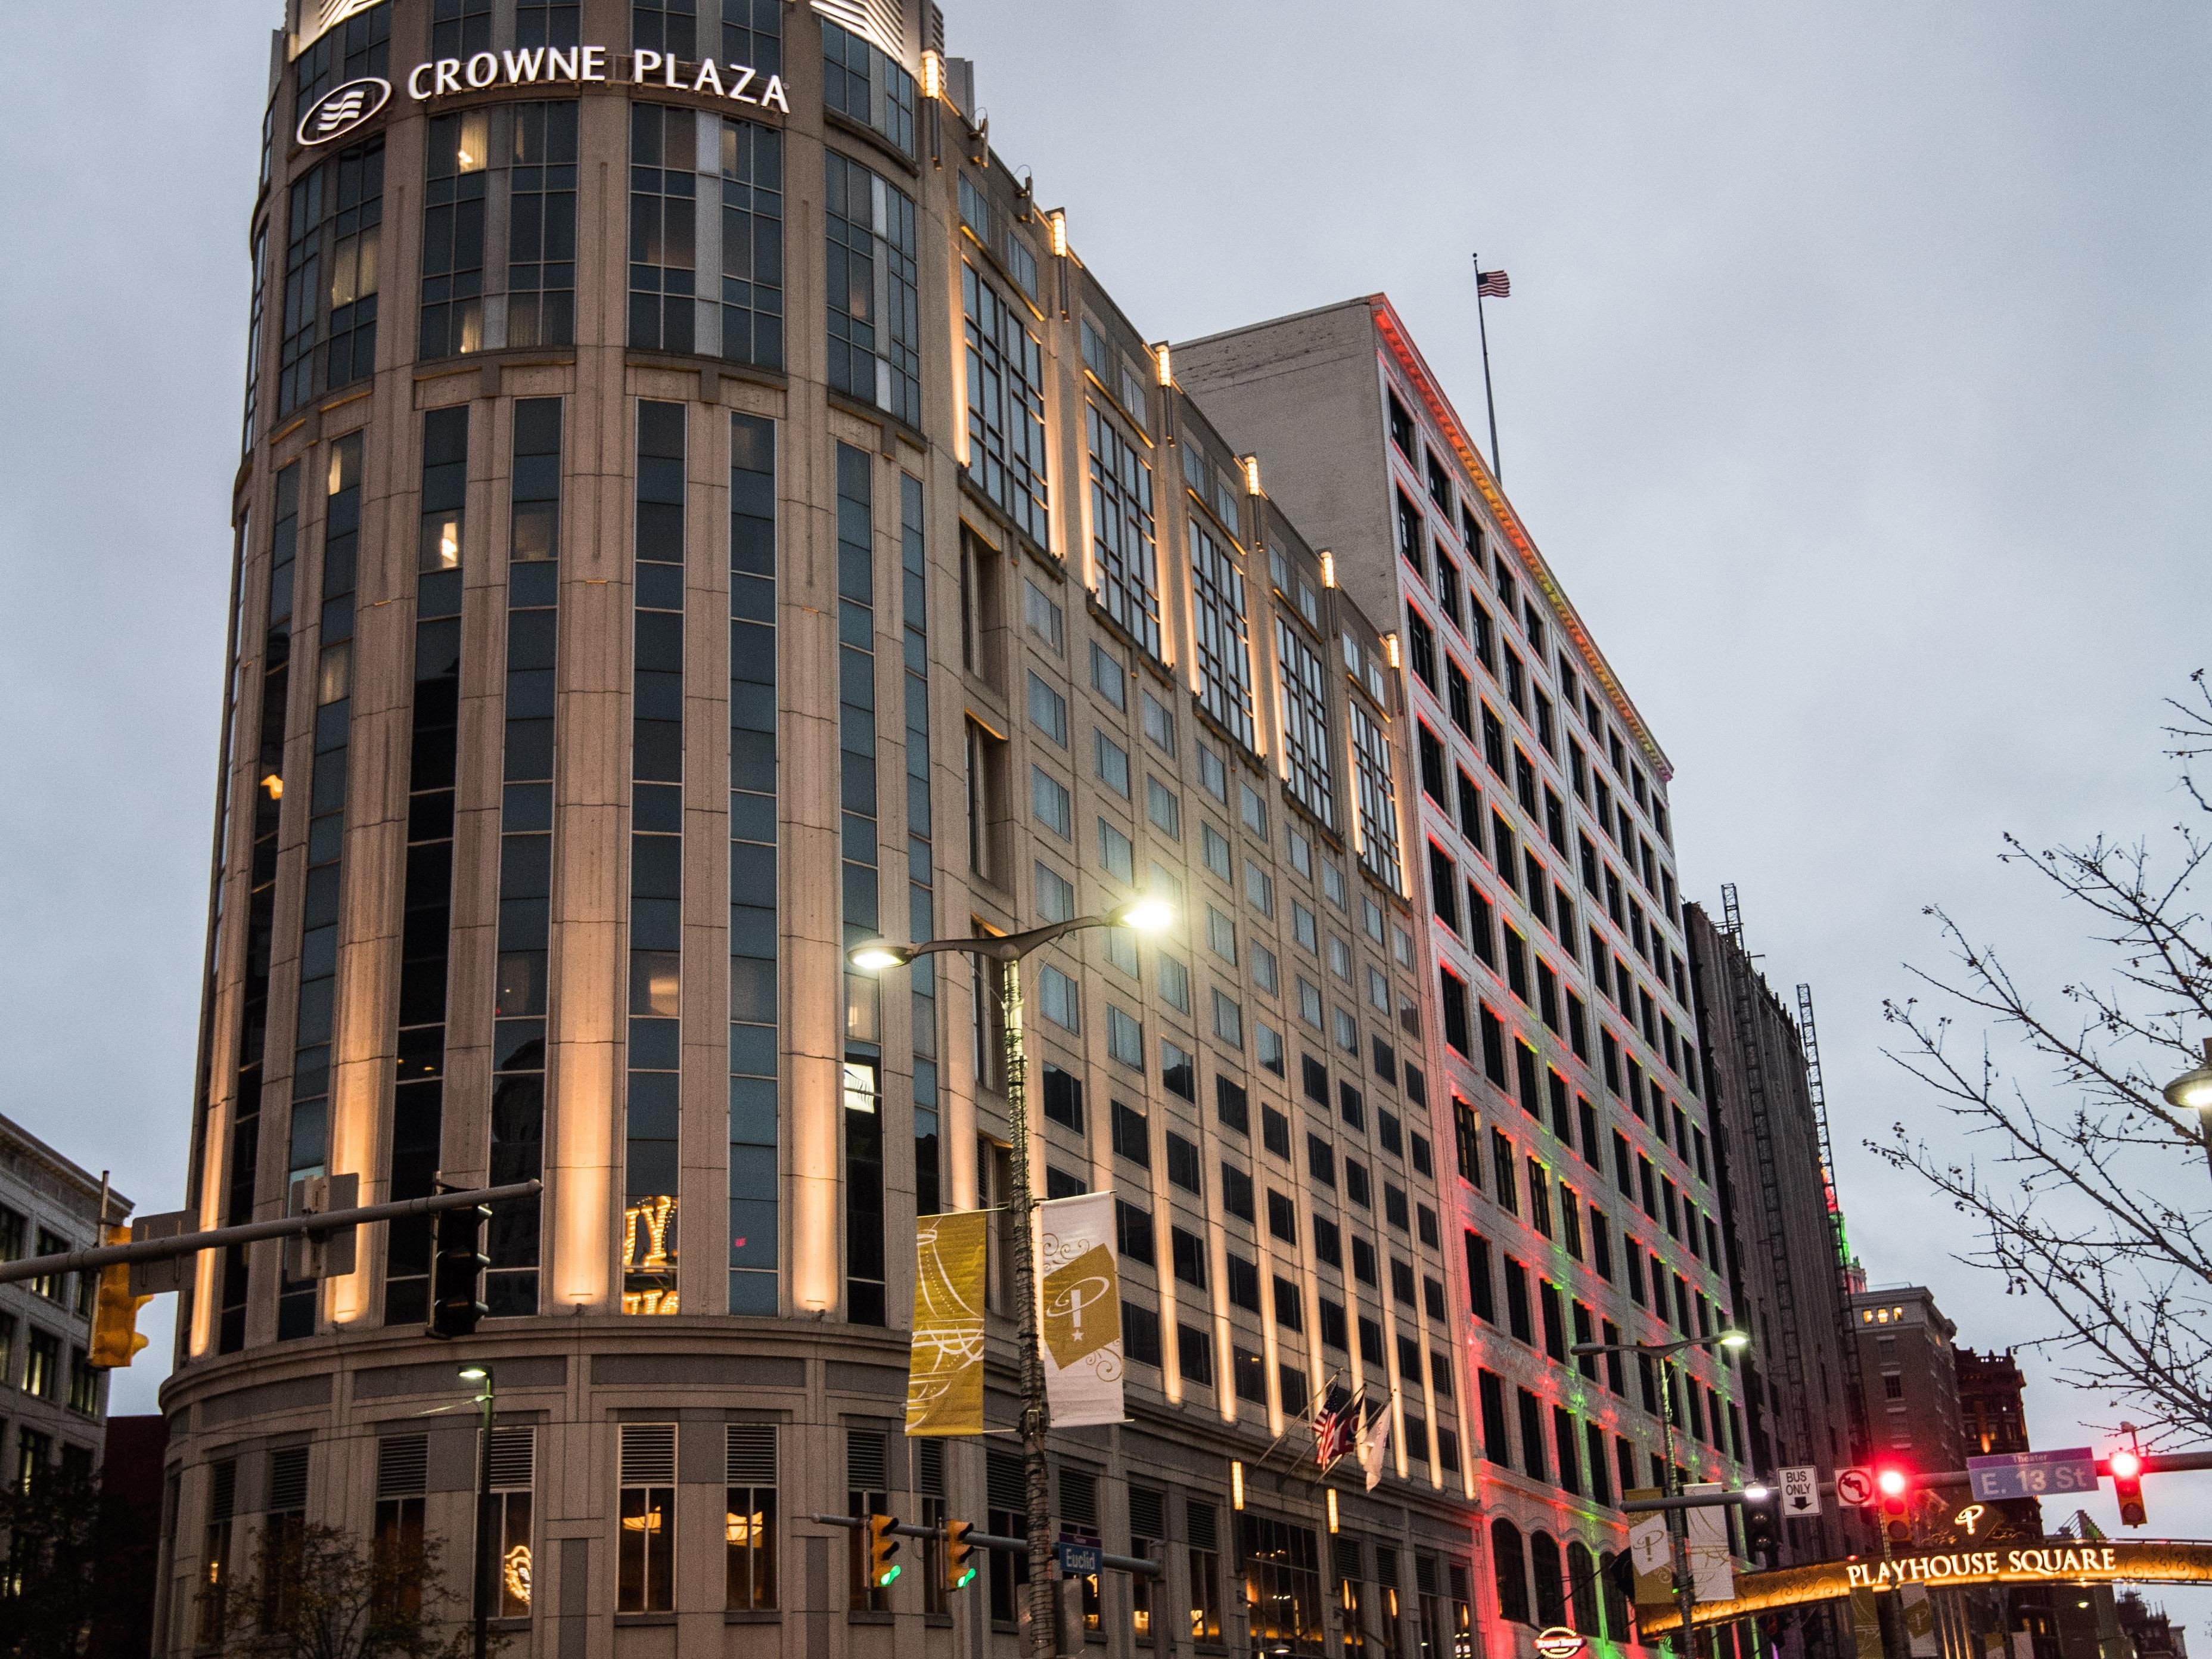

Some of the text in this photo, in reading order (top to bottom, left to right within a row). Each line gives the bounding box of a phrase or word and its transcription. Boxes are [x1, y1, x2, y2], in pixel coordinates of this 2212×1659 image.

[408, 46, 790, 114] CROWNE PLAZA
[2012, 1453, 2048, 1464] Theater
[1786, 1471, 1807, 1483] BUS
[1981, 1466, 2087, 1496] E. 13 St
[1785, 1483, 1811, 1496] ONLY
[1065, 1548, 1096, 1571] Euclid
[1846, 1548, 2116, 1587] PLAYHOUSE SQUARE
